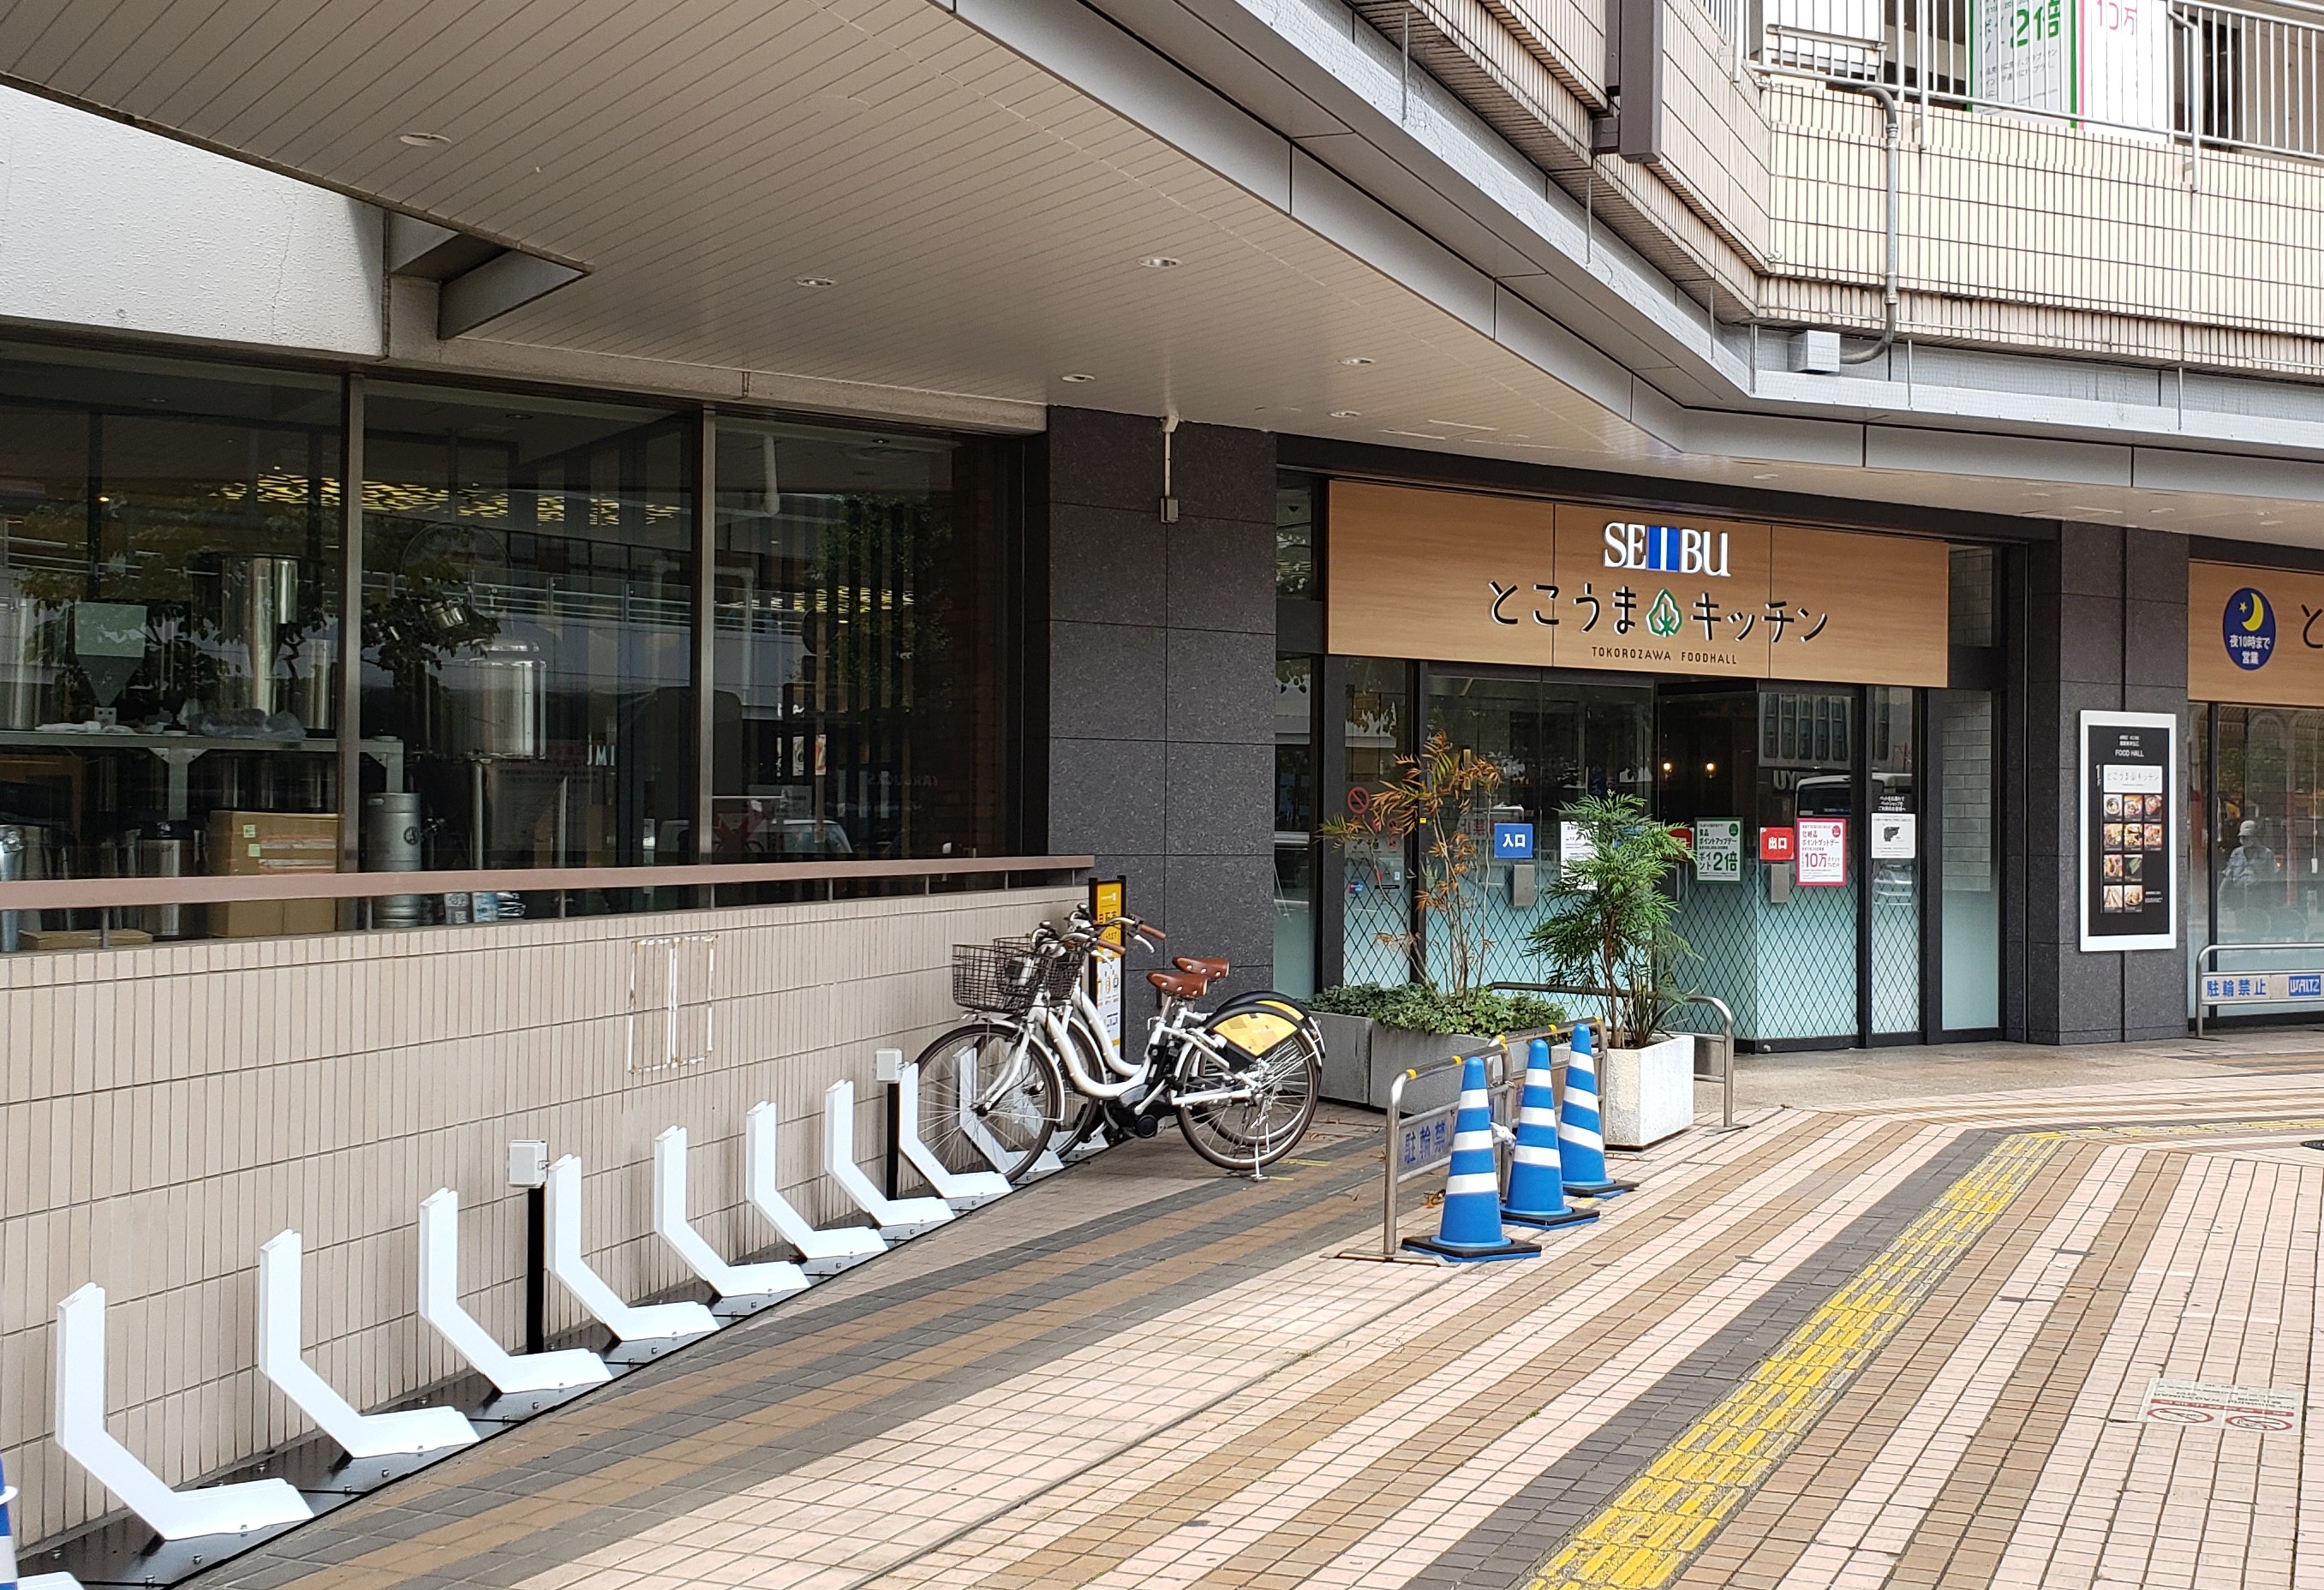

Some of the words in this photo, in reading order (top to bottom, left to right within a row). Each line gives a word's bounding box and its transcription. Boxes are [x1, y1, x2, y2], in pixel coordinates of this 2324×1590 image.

[1603, 521, 1731, 577] SEIBU
[1488, 580, 1637, 636] とこうま
[1690, 592, 1828, 643] キッチン
[2301, 604, 2324, 649] と
[2229, 634, 2270, 650] 夜10時まで
[1592, 646, 1671, 661] TOKOROZAWA
[1681, 651, 1737, 665] FOODHALL
[2241, 650, 2259, 665] 営業
[1503, 833, 1526, 848] 入口
[1768, 836, 1788, 850] 出口
[1713, 851, 1738, 871] 2倍
[1805, 852, 1827, 868] 10万
[2206, 978, 2267, 997] 駐輪禁止
[2290, 977, 2320, 994] WALTZ
